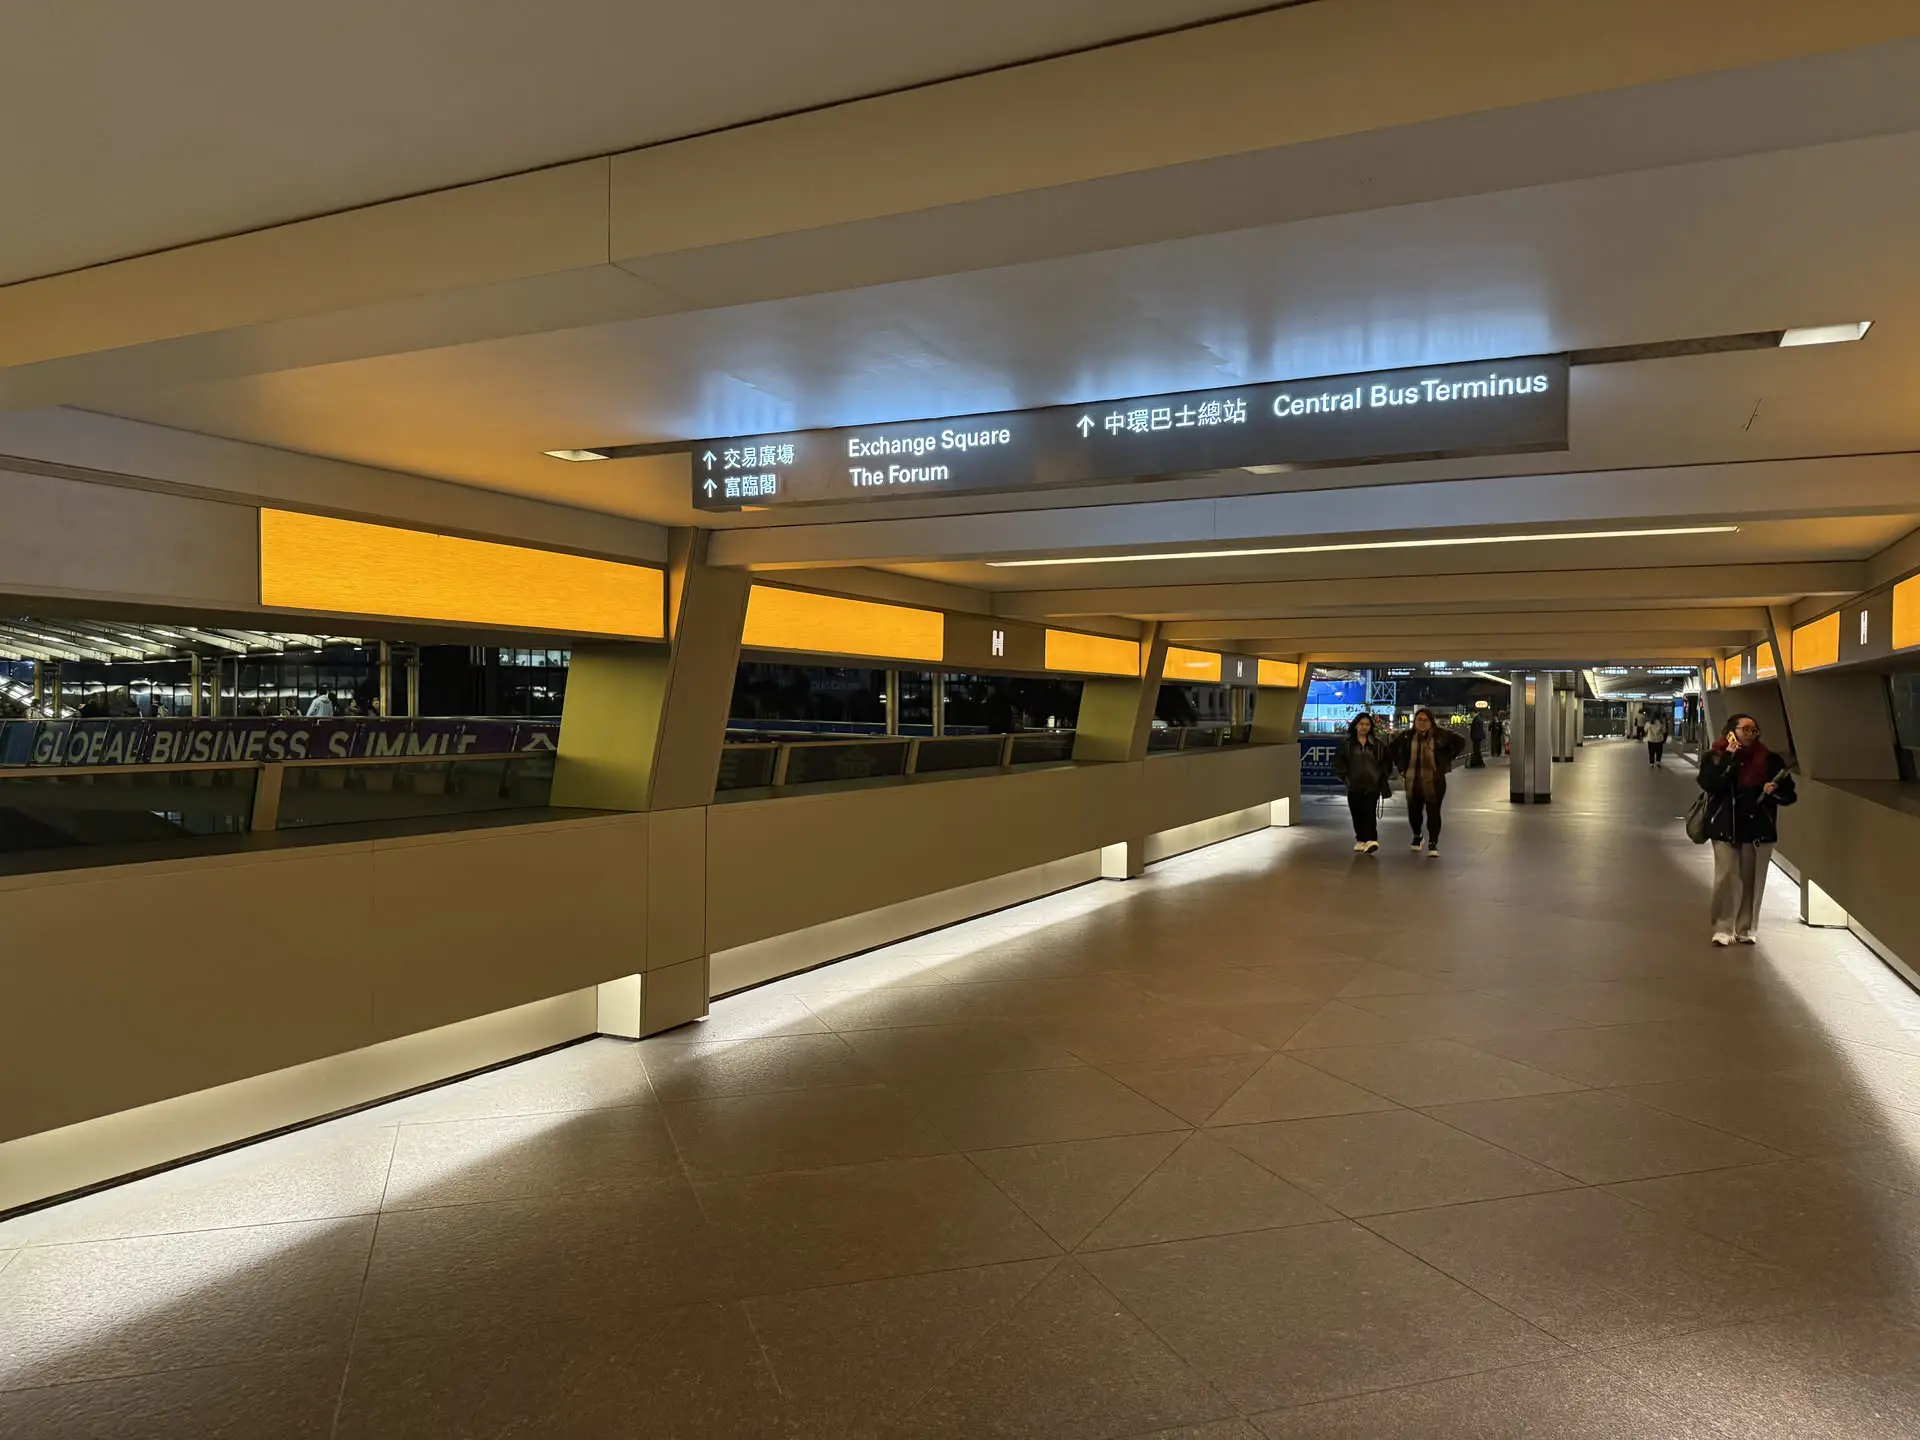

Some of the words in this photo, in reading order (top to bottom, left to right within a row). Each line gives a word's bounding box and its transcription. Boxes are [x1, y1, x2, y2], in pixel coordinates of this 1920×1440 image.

[1273, 388, 1361, 417] Central
[1371, 385, 1419, 408] Bus
[1421, 374, 1548, 402] Terminus
[1104, 397, 1247, 436] 中環巴士總站
[848, 436, 936, 457] Exchange
[941, 429, 1011, 451] Square
[724, 473, 777, 498] 富臨閣
[848, 467, 884, 487] The
[888, 464, 949, 484] Forum
[33, 732, 138, 764] GLOBAL
[150, 730, 309, 764] BUSINESS
[1301, 746, 1337, 761] AFF
